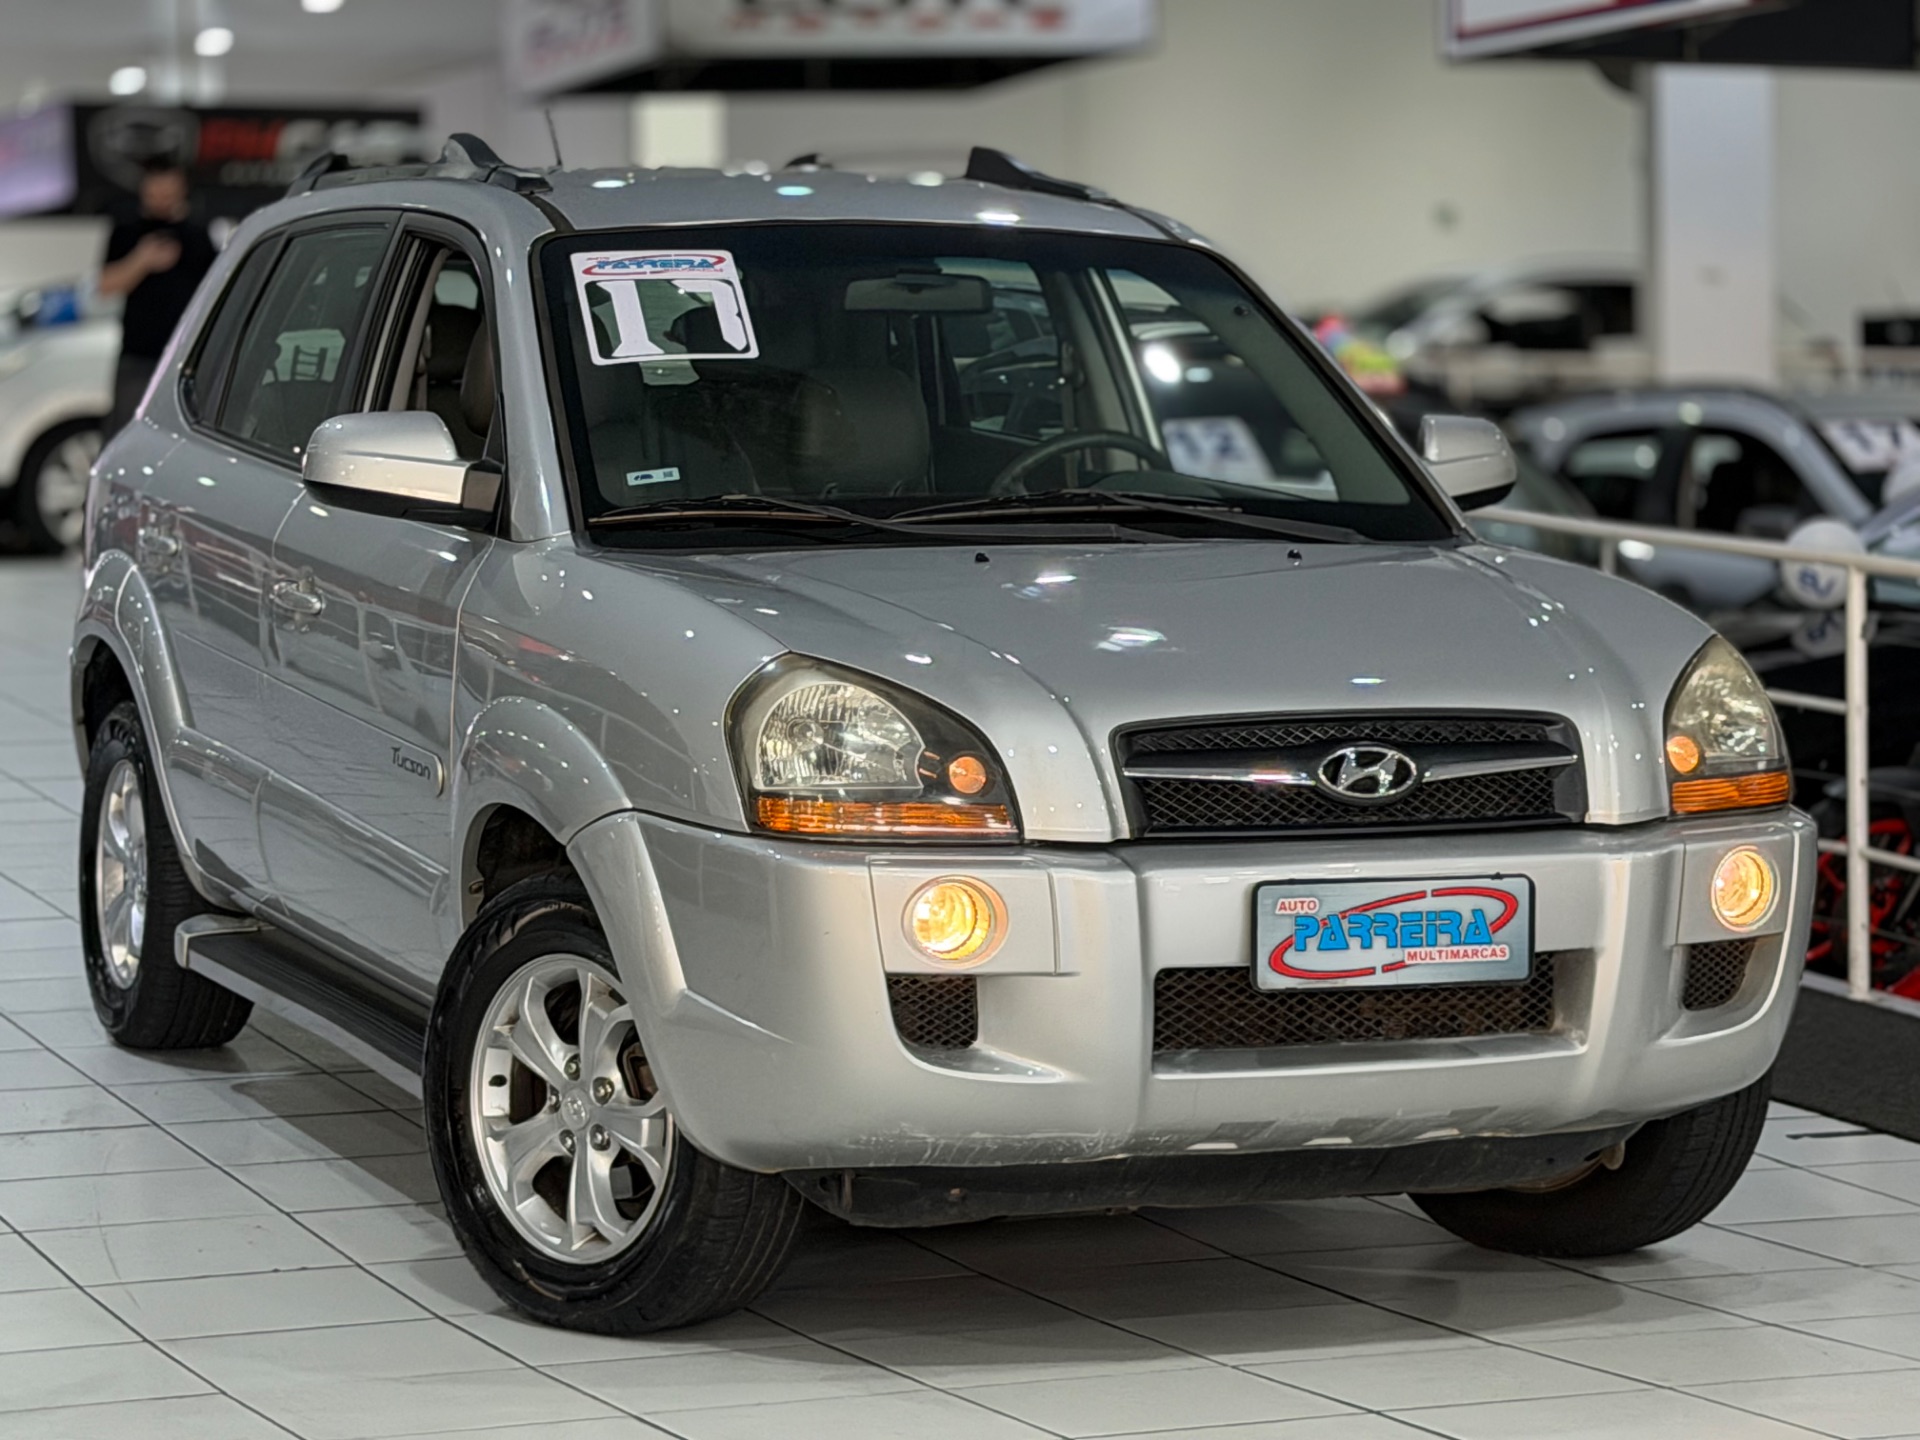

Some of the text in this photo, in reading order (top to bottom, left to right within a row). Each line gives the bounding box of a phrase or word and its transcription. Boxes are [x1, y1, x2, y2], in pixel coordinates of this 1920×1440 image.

[391, 746, 431, 780] Tucson
[1278, 900, 1317, 912] AUTO
[1294, 908, 1493, 952] PARREIRA
[1407, 947, 1507, 961] MULTIMARCAS
